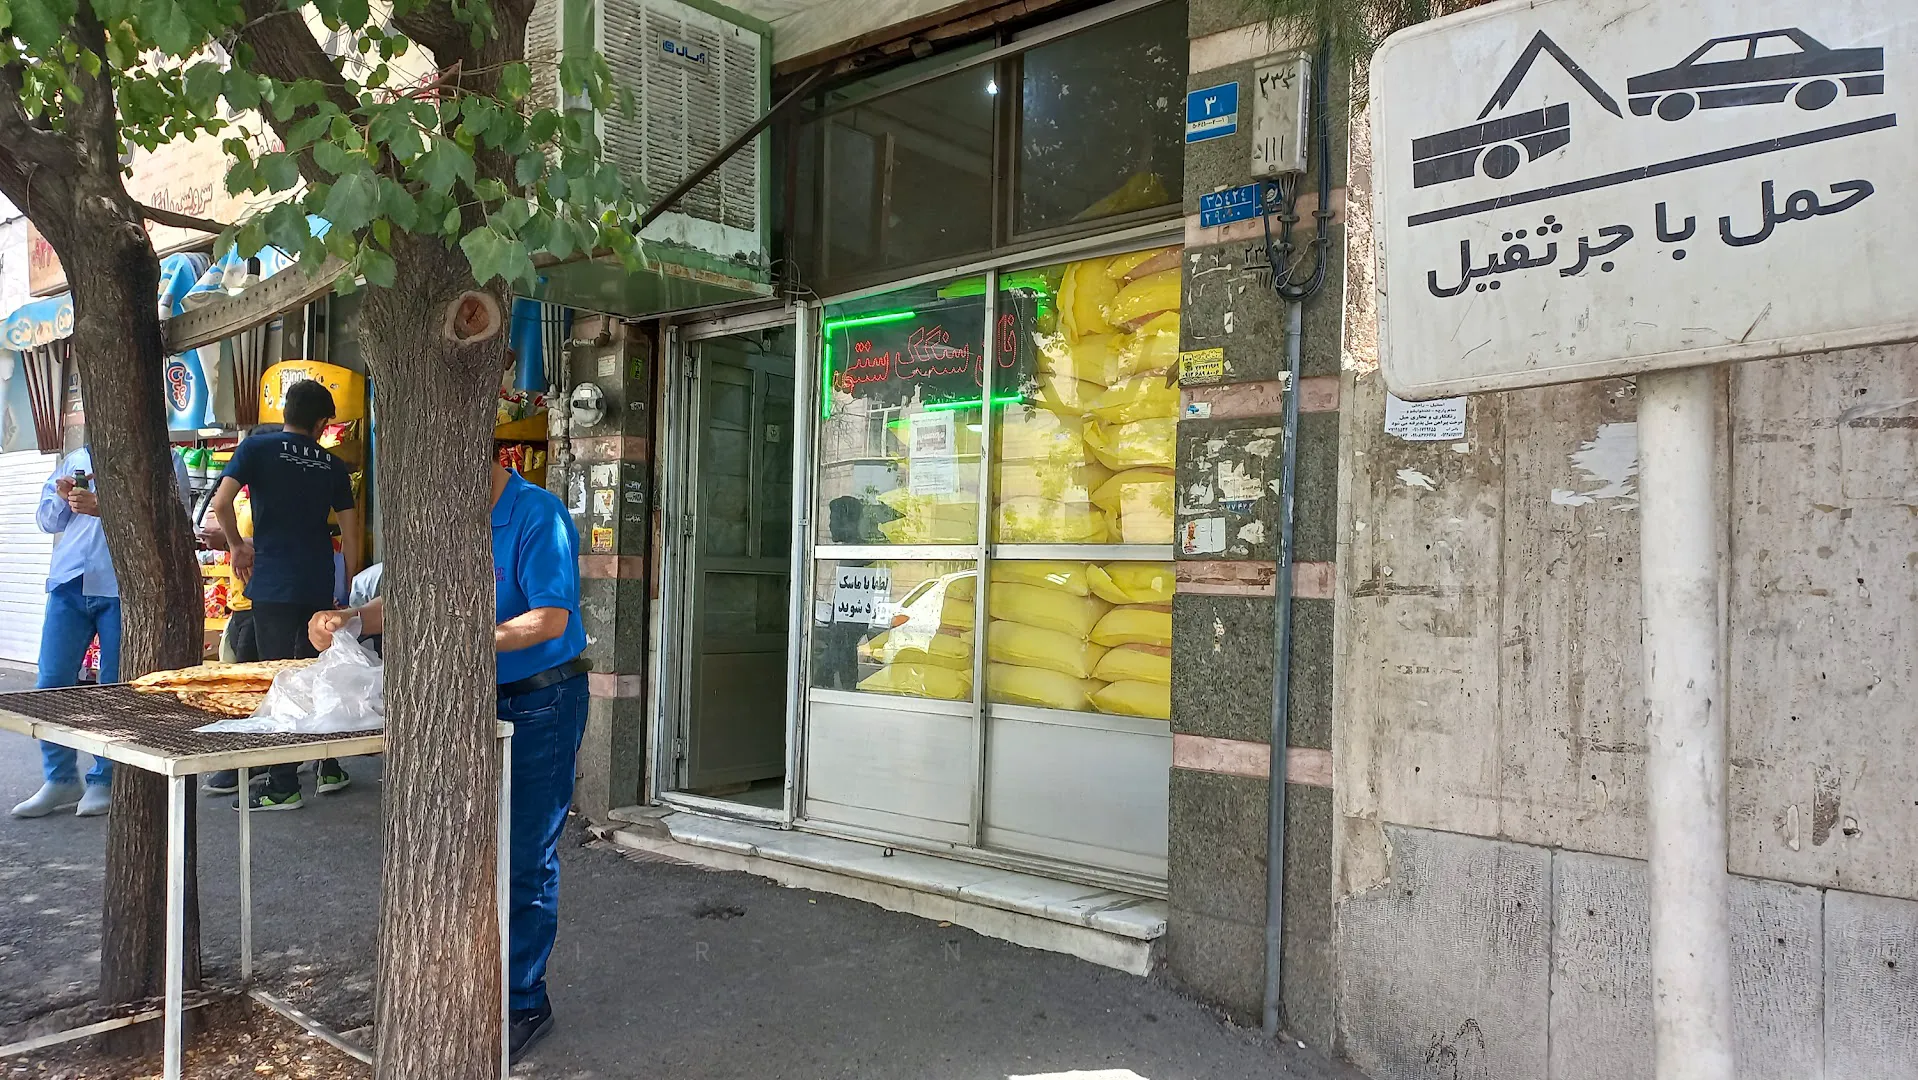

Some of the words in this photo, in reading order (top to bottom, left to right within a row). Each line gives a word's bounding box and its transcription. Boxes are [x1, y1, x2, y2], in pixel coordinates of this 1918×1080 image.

[1655, 202, 1698, 260] با
[1719, 178, 1876, 248] حمل
[894, 325, 970, 380] سنگک
[281, 441, 332, 462] TOKYO
[839, 575, 862, 590] ماسک
[838, 599, 863, 618] شوید
